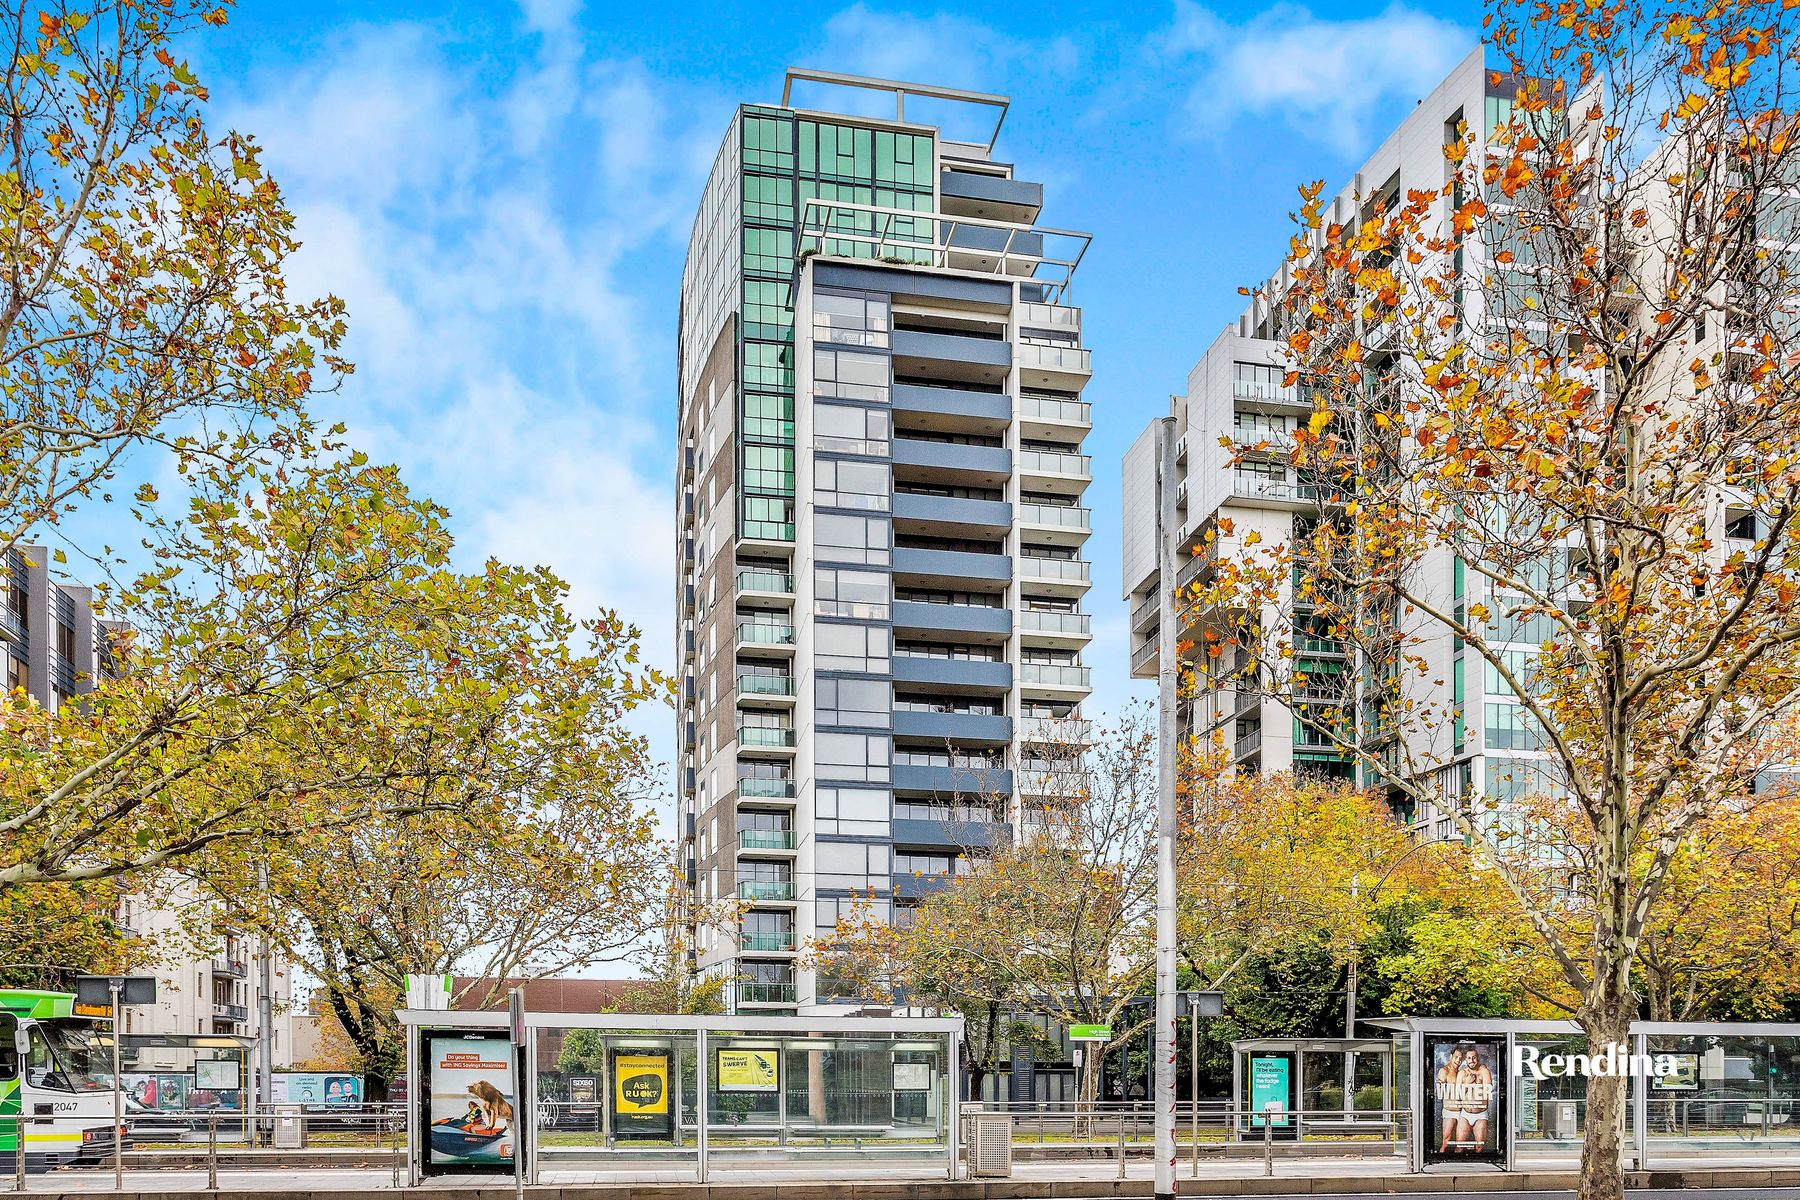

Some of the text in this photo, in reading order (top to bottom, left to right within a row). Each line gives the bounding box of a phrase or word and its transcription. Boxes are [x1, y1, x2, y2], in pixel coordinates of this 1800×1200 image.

[633, 1081, 650, 1090] Ask
[1437, 1083, 1494, 1100] WINTER
[54, 1102, 78, 1111] 2047
